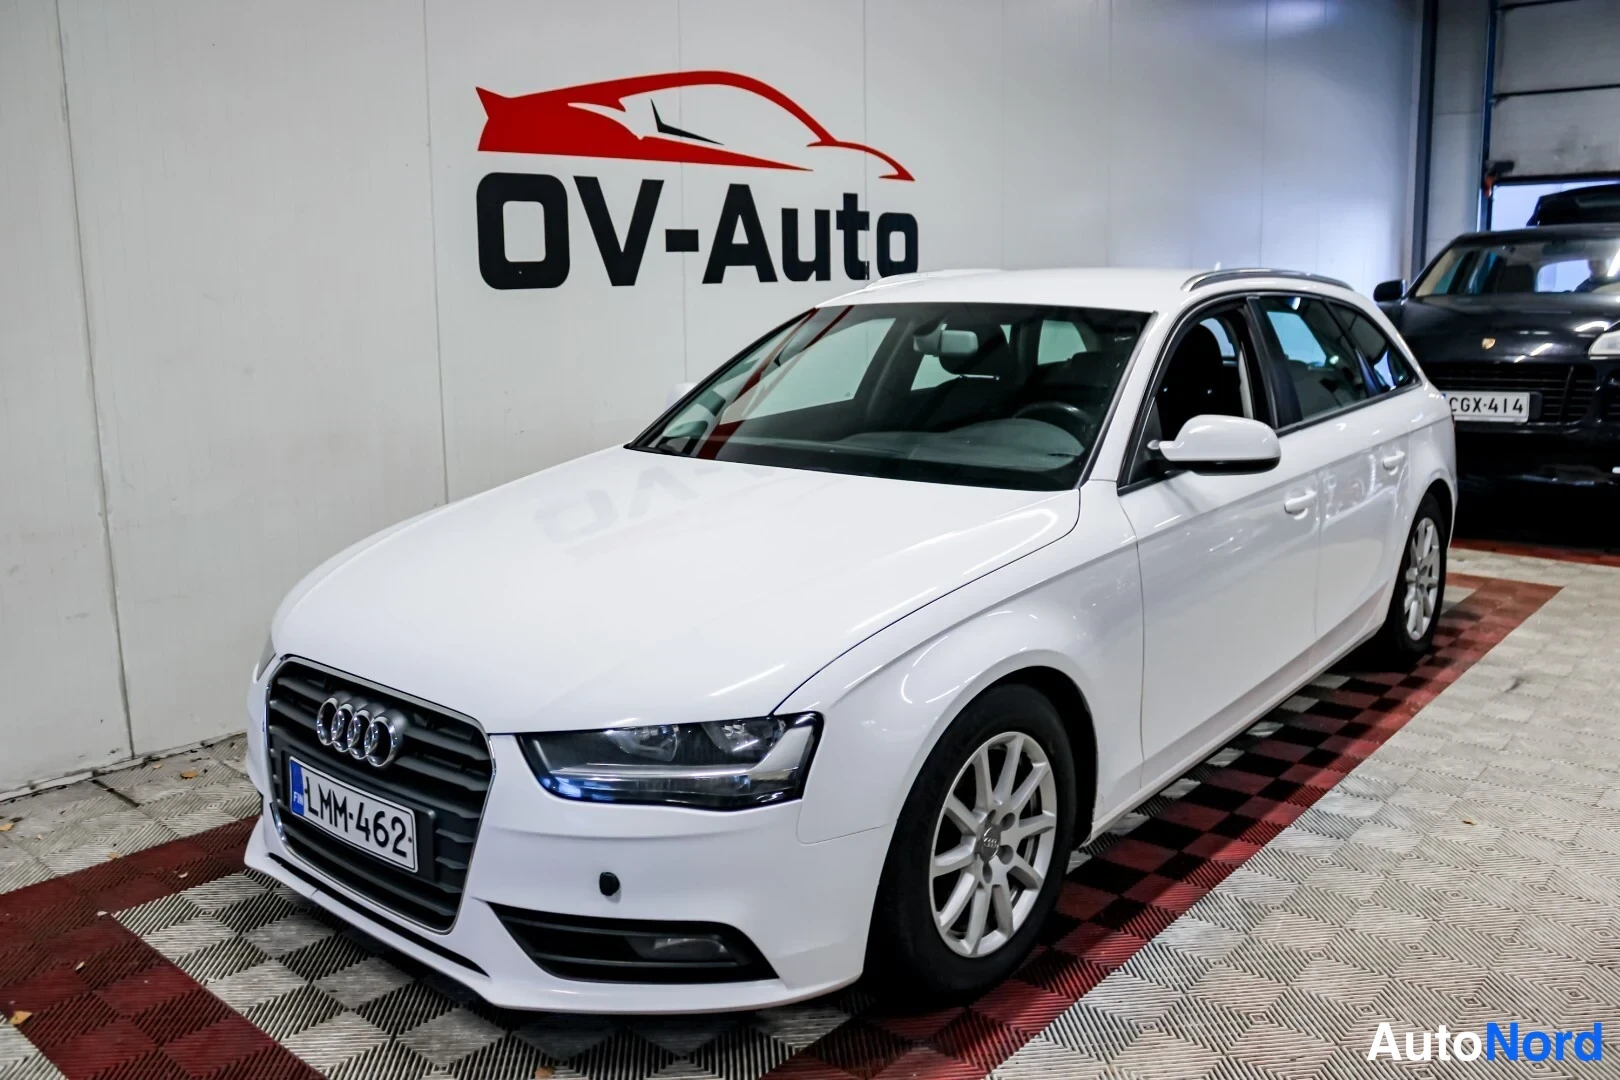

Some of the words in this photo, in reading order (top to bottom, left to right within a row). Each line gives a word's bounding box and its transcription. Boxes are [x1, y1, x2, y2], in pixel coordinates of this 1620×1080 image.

[476, 172, 919, 290] OV-Auto
[1449, 397, 1523, 414] CGX-414
[305, 776, 408, 858] LMM-462
